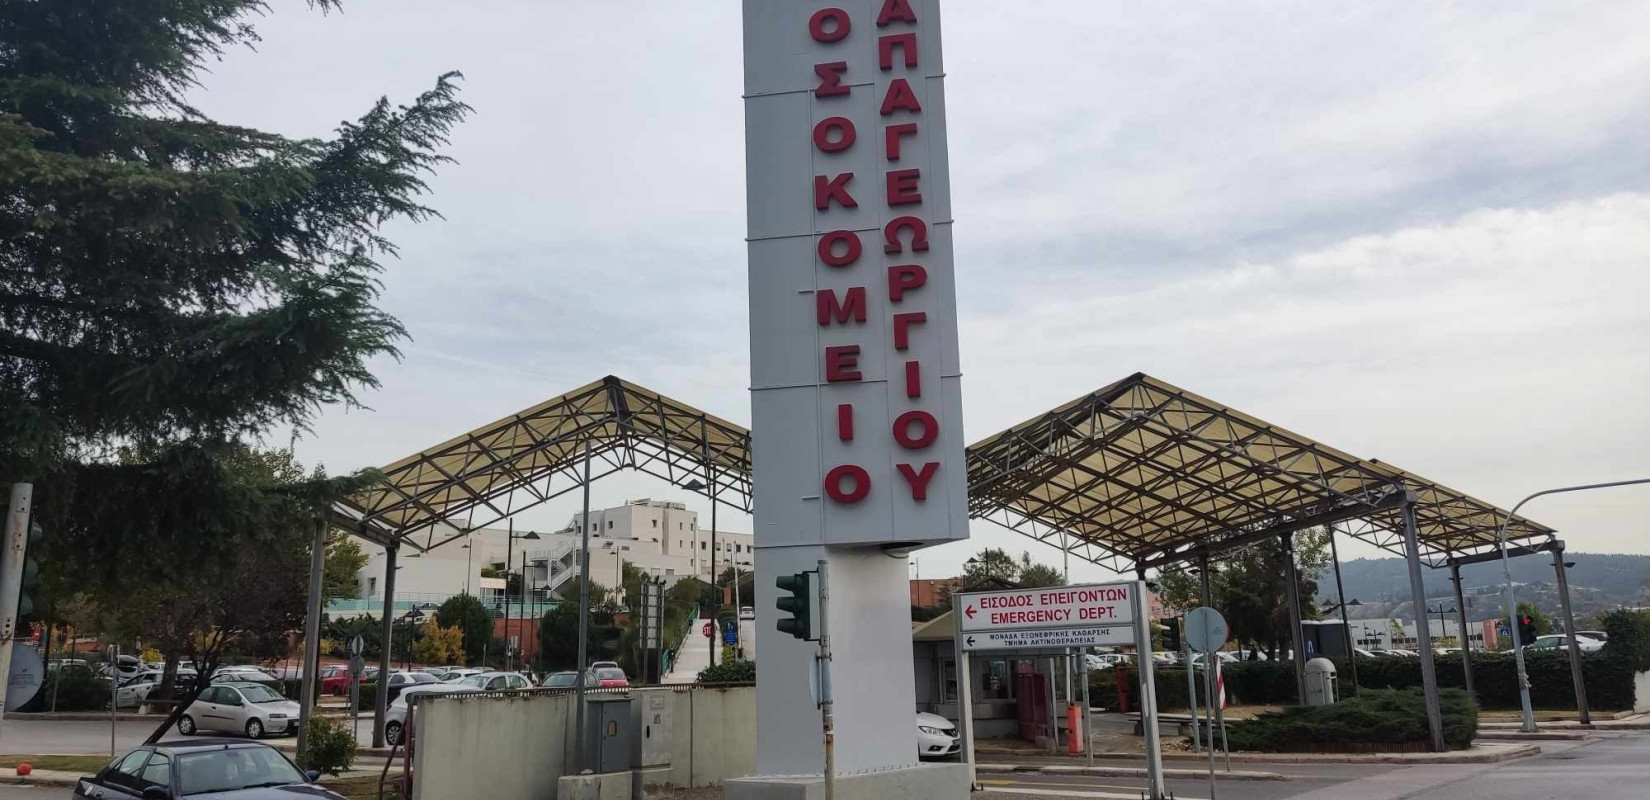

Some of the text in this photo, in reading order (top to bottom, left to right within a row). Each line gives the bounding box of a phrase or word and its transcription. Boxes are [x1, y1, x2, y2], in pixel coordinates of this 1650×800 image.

[809, 0, 871, 504] ΟΣΟΚΟΜΕΙΟ
[980, 588, 1127, 609] ΕΙΣΟΔΟΣ ΕΠΕΙΓΟΝΤΩΝ
[991, 606, 1117, 624] EMERGENCY DEPT.
[1030, 636, 1096, 646] ΑΚΤΙΝΟΘΕΡΑΠΕΙΑΣ
[1072, 628, 1110, 637] ΚΑΘΑΡΣΗΣ
